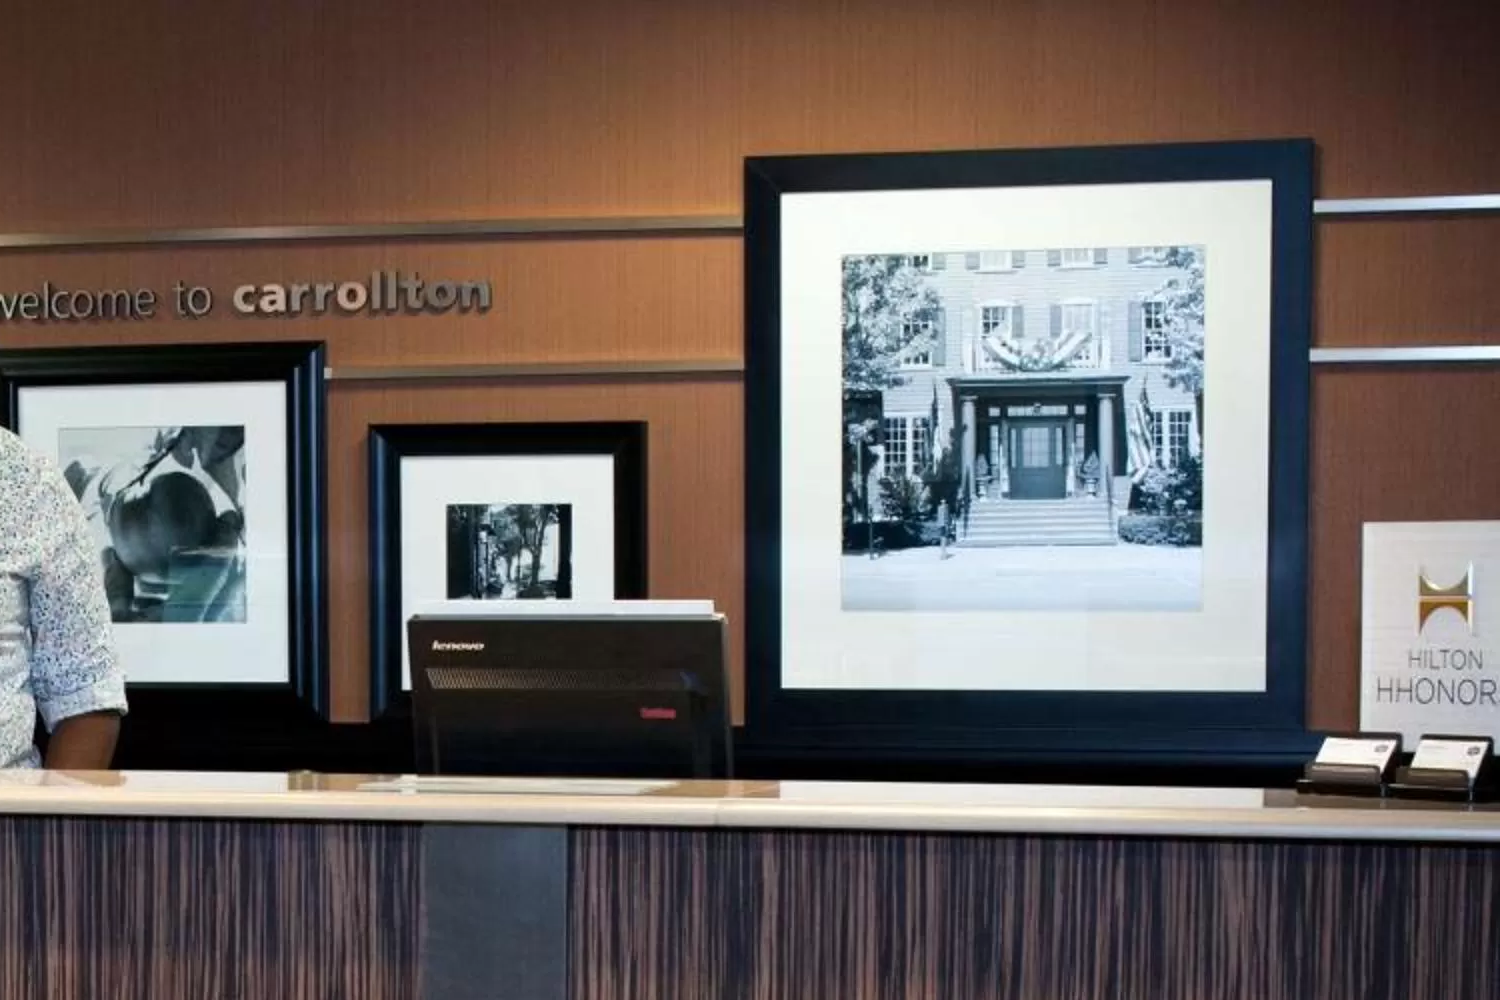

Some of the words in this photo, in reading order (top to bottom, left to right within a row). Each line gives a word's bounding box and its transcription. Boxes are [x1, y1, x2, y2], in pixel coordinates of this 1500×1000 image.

[173, 281, 211, 314] to
[233, 270, 490, 313] carrollton
[432, 640, 484, 651] lenovo
[1408, 647, 1482, 670] HILTON
[1376, 677, 1500, 705] HHONOR
